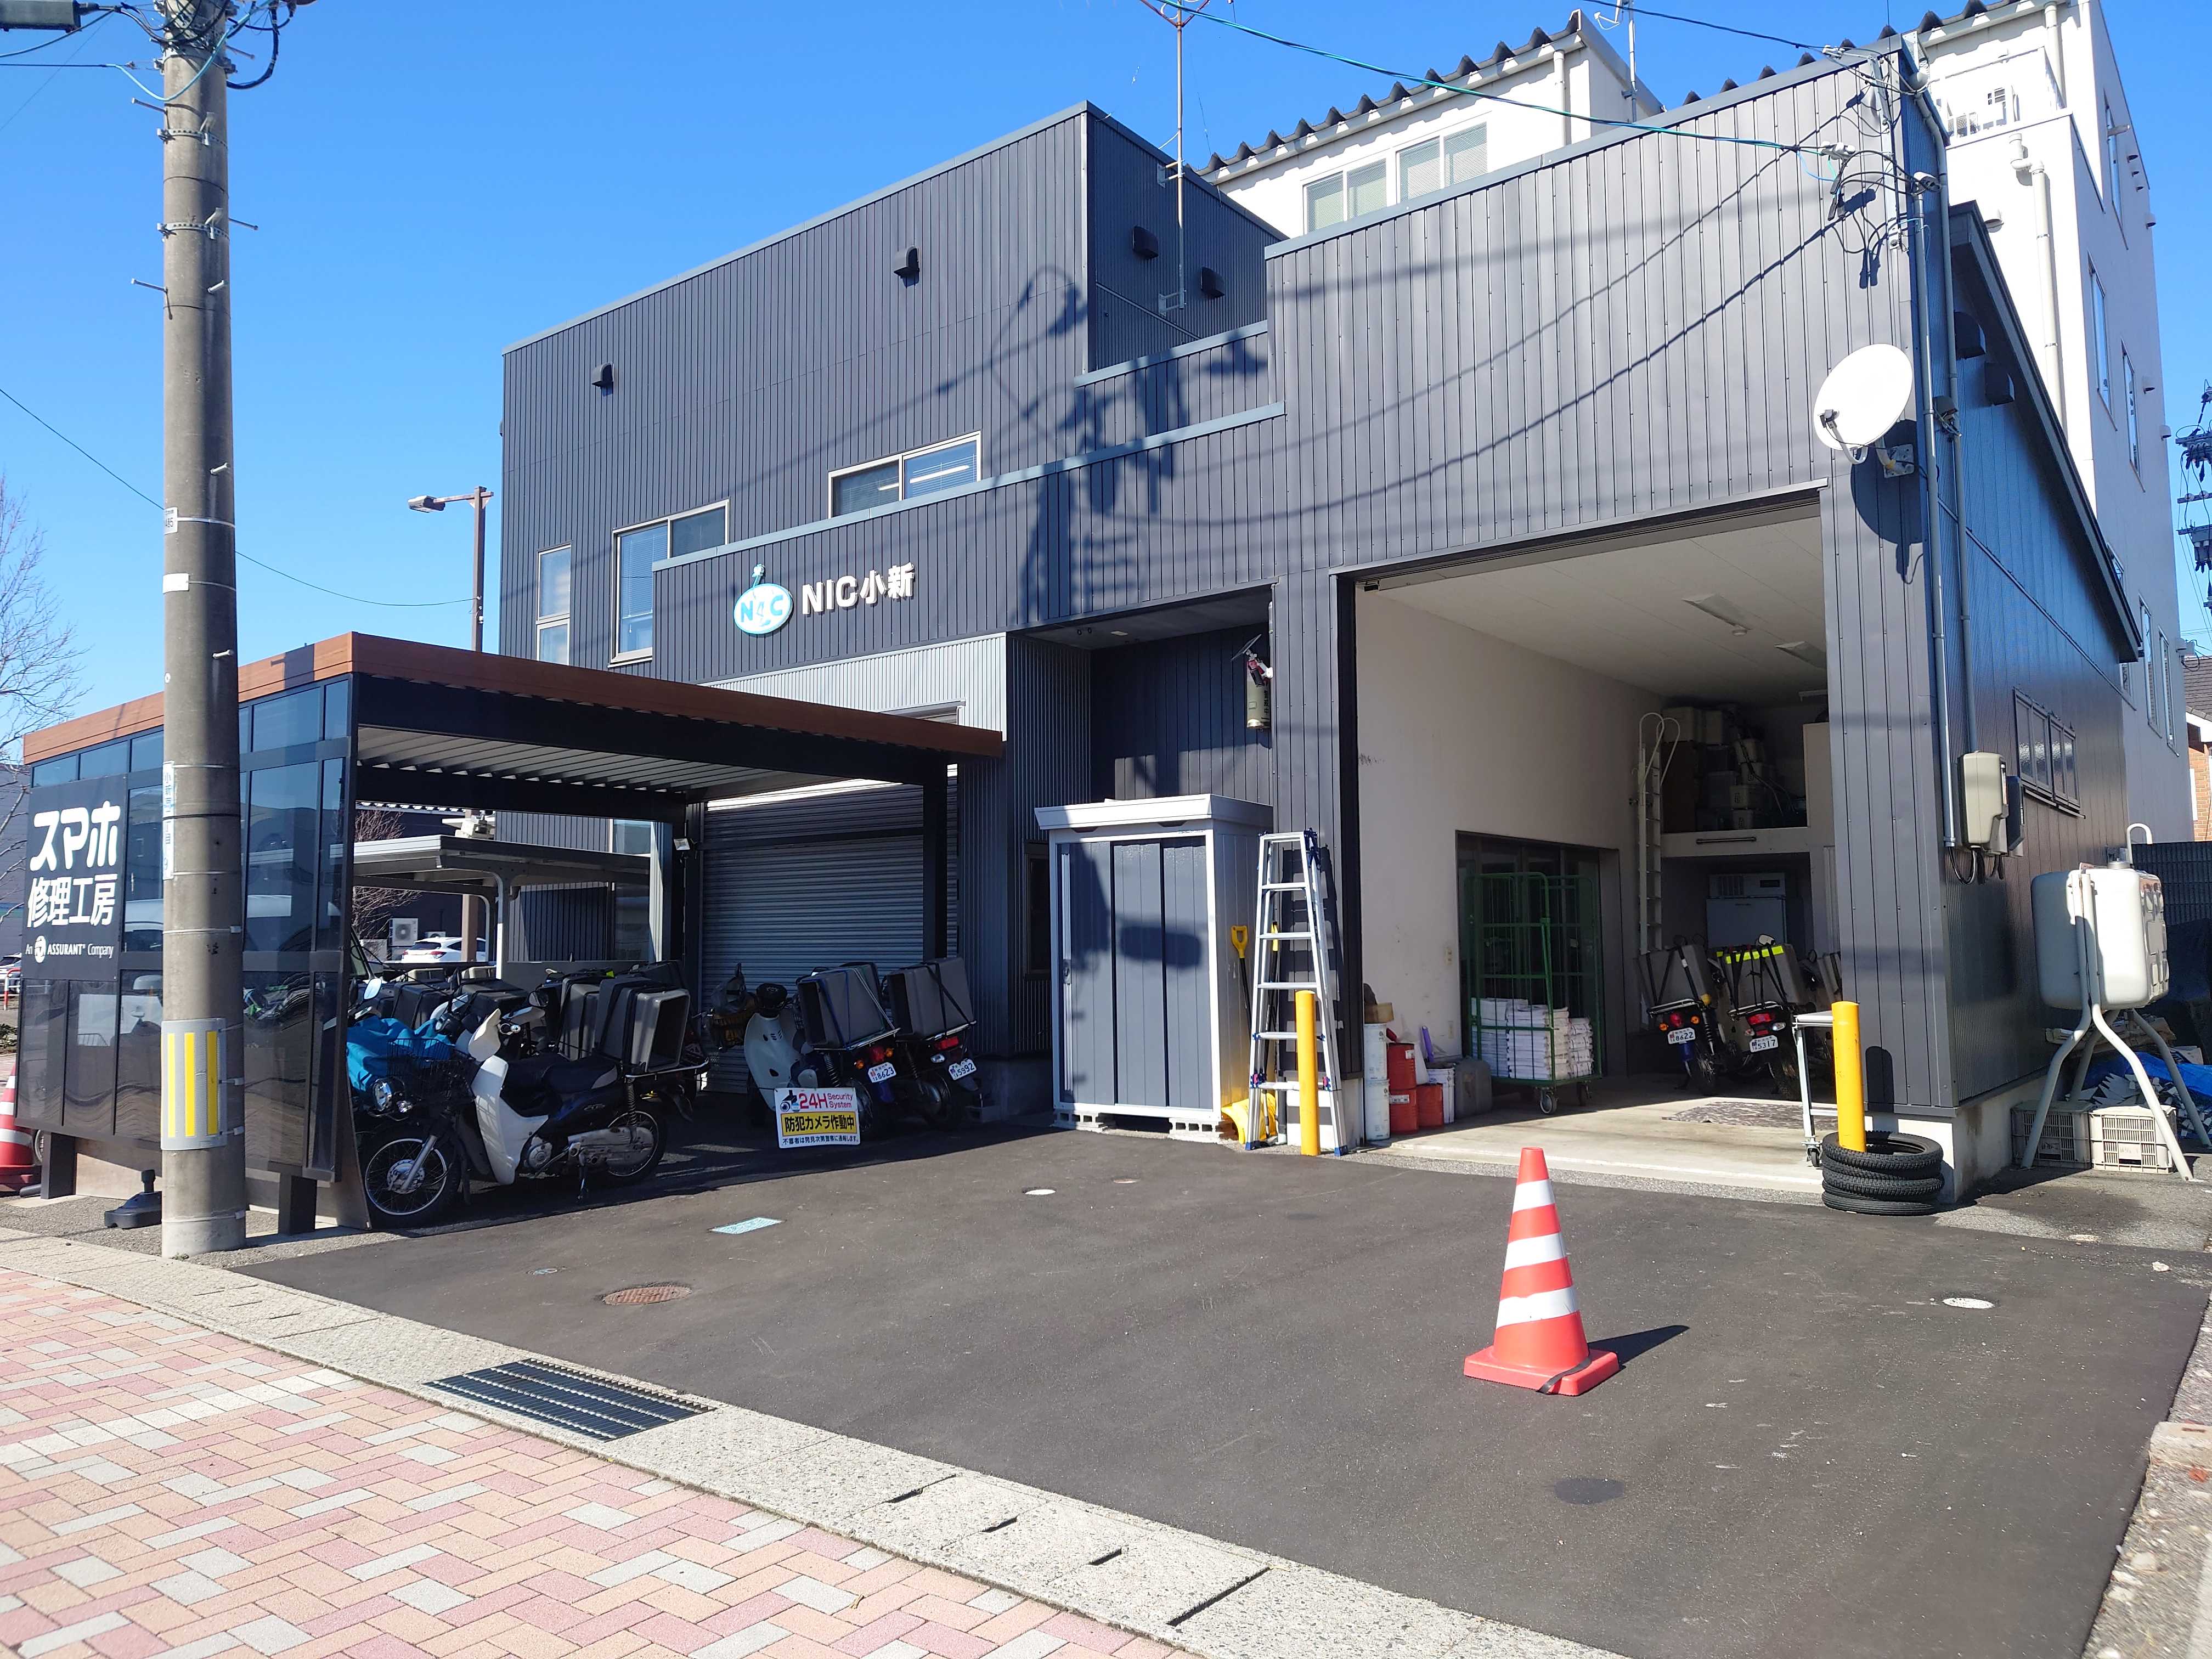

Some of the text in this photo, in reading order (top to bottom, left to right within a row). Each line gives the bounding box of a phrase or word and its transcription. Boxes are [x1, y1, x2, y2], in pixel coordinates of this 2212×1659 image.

[802, 562, 915, 615] NIC小新
[29, 800, 121, 871] スマホ
[27, 873, 117, 928] 修理工房
[25, 944, 33, 955] An
[87, 943, 114, 959] Company
[1675, 1031, 1694, 1041] 8622
[1757, 1039, 1776, 1049] 5317
[877, 1066, 894, 1079] 8623
[957, 1062, 975, 1076] 5992
[799, 1093, 828, 1109] 24H
[828, 1093, 853, 1101] Security
[829, 1101, 852, 1109] System
[785, 1115, 854, 1132] 防犯カメラ作動中
